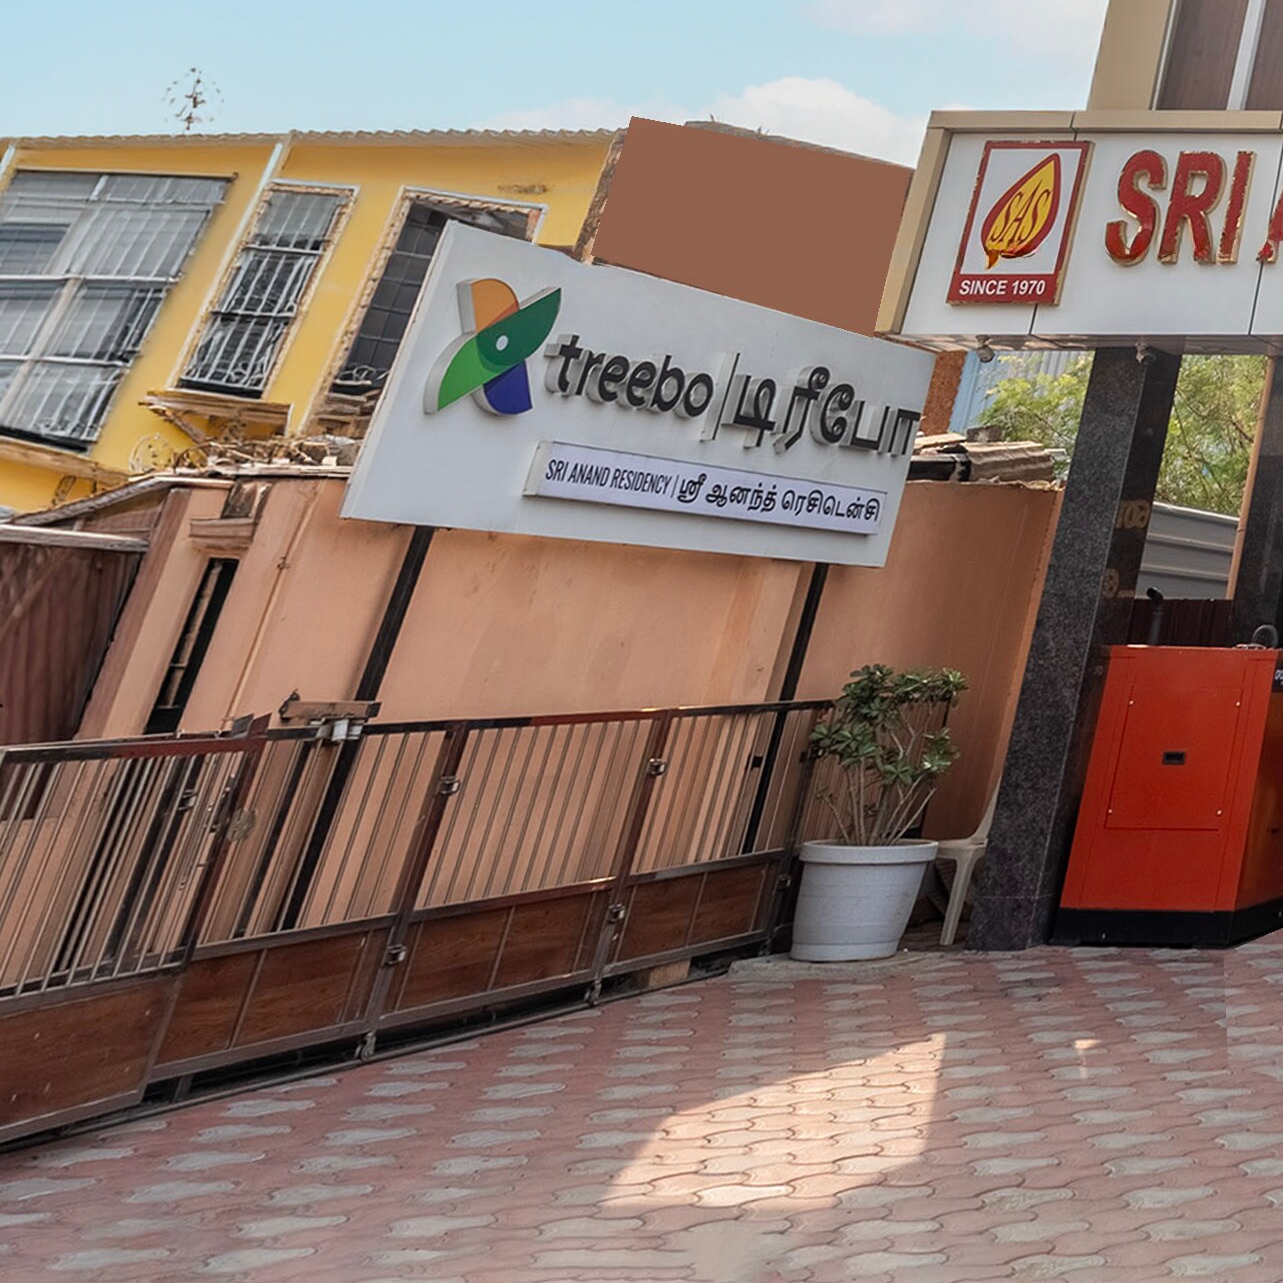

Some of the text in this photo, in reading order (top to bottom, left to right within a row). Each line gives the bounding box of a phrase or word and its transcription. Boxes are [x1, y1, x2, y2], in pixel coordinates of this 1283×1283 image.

[990, 179, 1054, 245] SAS
[1105, 149, 1257, 265] SRI
[959, 280, 1046, 295] SINCE 1970
[545, 333, 714, 419] treebo
[545, 459, 567, 482] SRI
[567, 462, 611, 487] ANAND
[611, 469, 673, 496] RESIDENCY
[705, 481, 777, 512] ஆனந்த்
